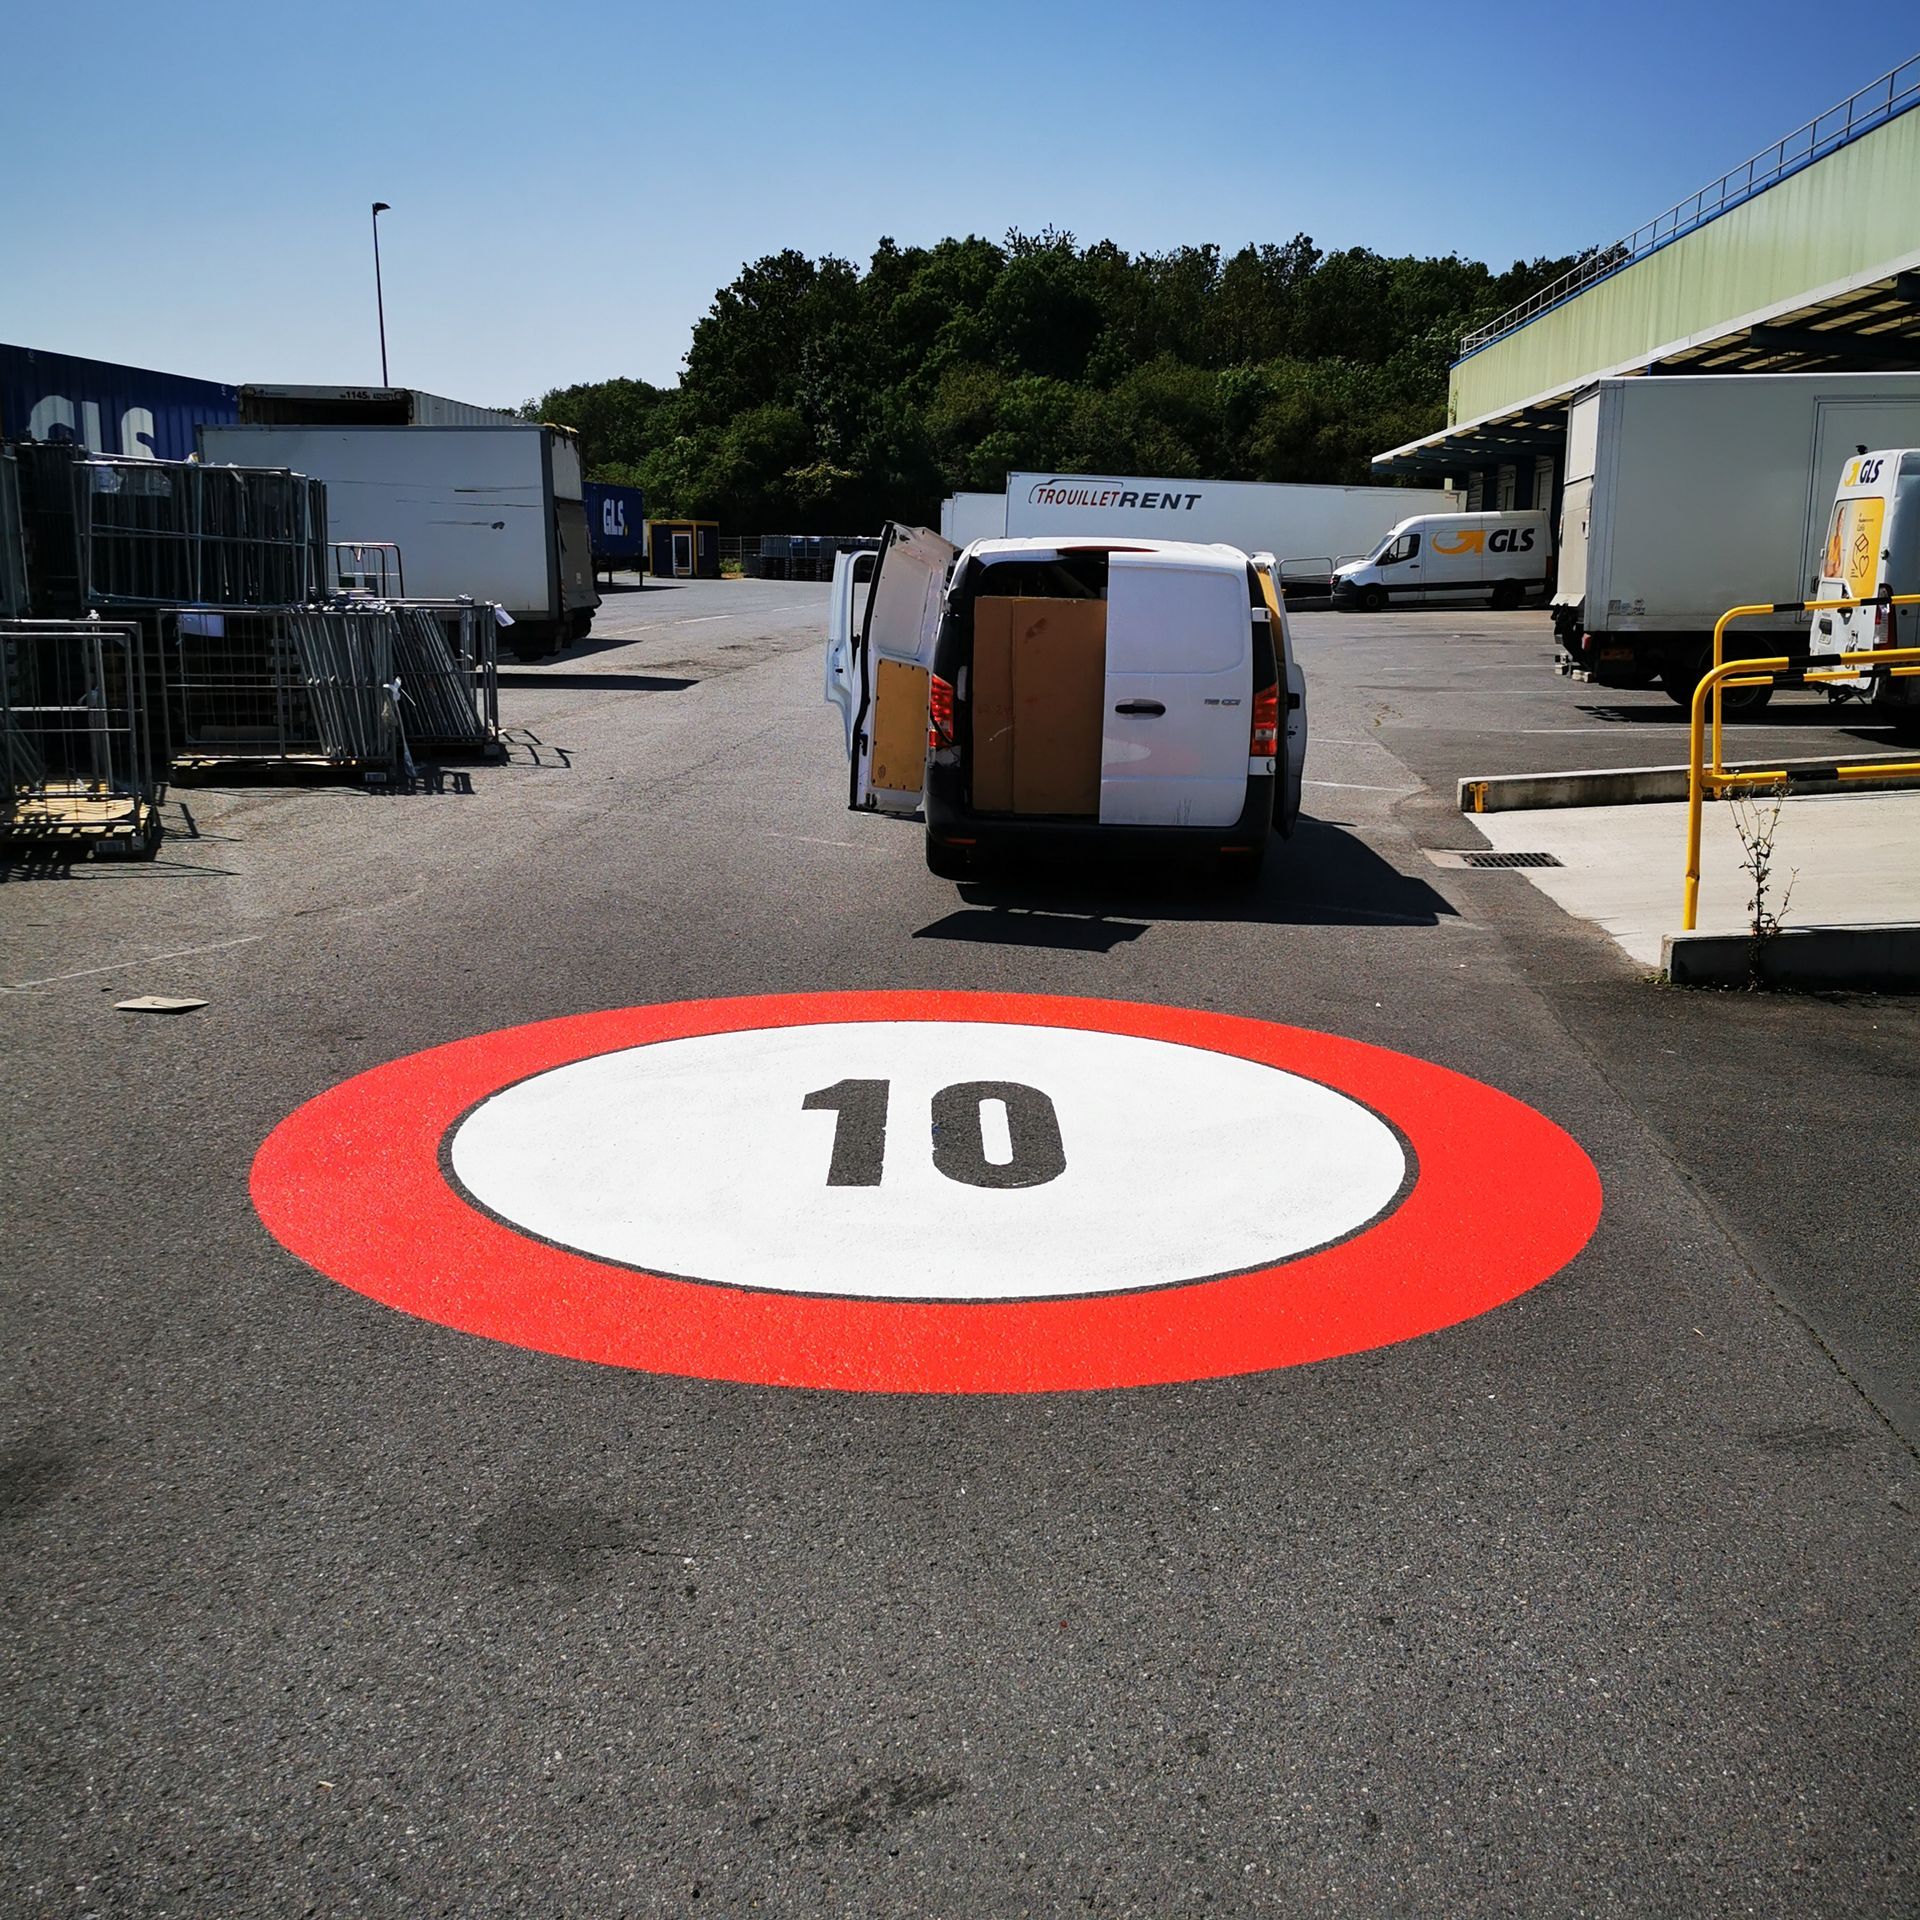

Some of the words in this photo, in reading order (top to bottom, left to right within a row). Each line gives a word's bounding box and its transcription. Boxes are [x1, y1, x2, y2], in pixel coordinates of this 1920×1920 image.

[1859, 459, 1884, 484] GLS
[1488, 528, 1535, 553] GLS
[801, 1078, 1067, 1190] 10
